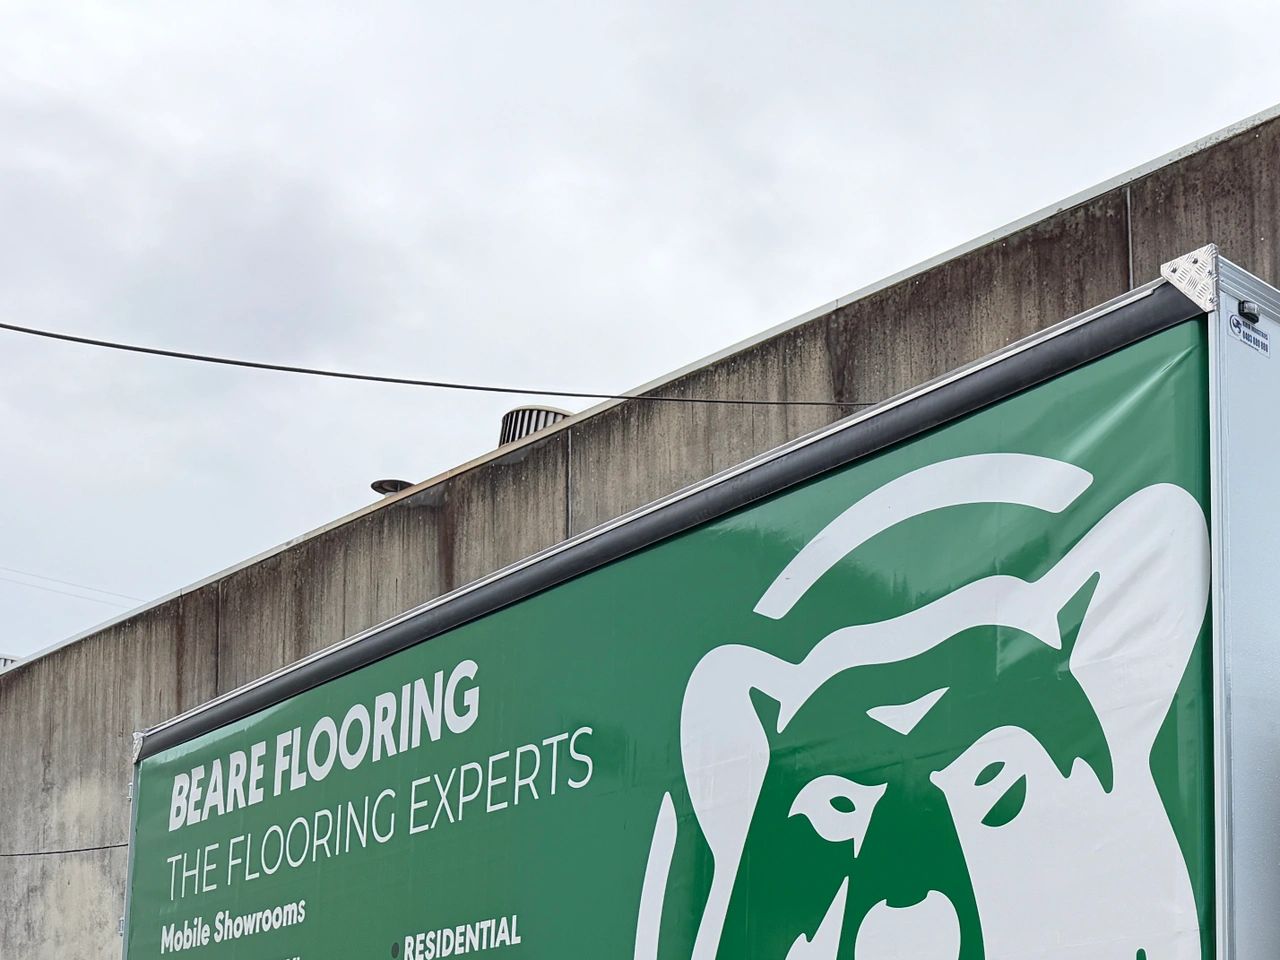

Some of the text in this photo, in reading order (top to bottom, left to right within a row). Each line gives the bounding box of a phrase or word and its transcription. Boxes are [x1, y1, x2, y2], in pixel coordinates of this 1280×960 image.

[167, 727, 592, 900] THE FLOORING EXPERTS
[169, 660, 480, 832] BEARE FLOORING
[161, 900, 305, 954] Mobile Showrooms
